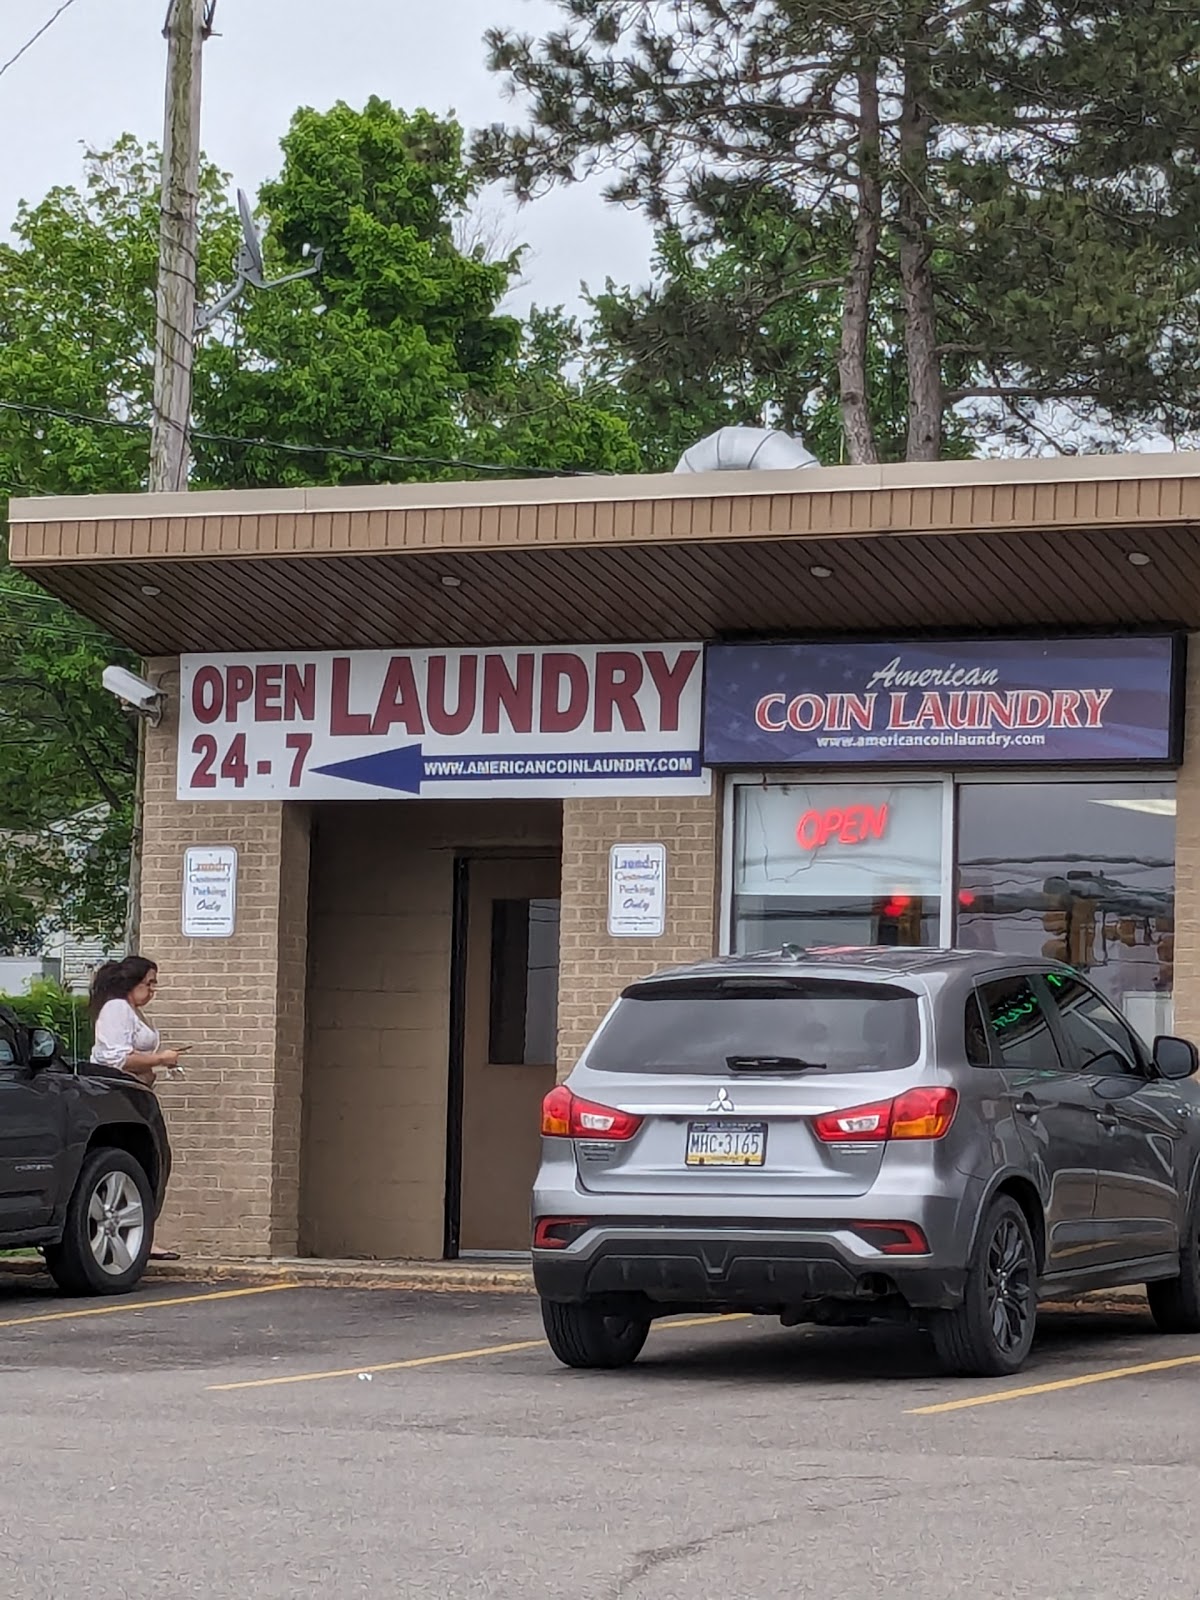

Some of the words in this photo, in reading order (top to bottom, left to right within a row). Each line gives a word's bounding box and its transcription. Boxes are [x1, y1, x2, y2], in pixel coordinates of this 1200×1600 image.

[191, 663, 317, 724] OPEN
[329, 649, 702, 736] LAUNDRY
[866, 656, 1000, 690] American
[754, 692, 879, 732] COIN
[885, 688, 1114, 731] LAUNDRY
[189, 732, 313, 788] 24-7
[816, 731, 1046, 749] www.americancoinlaundry.com
[424, 757, 693, 776] WWW.AMERICANCOINLAUNDRY.COM
[796, 803, 888, 851] OPEN
